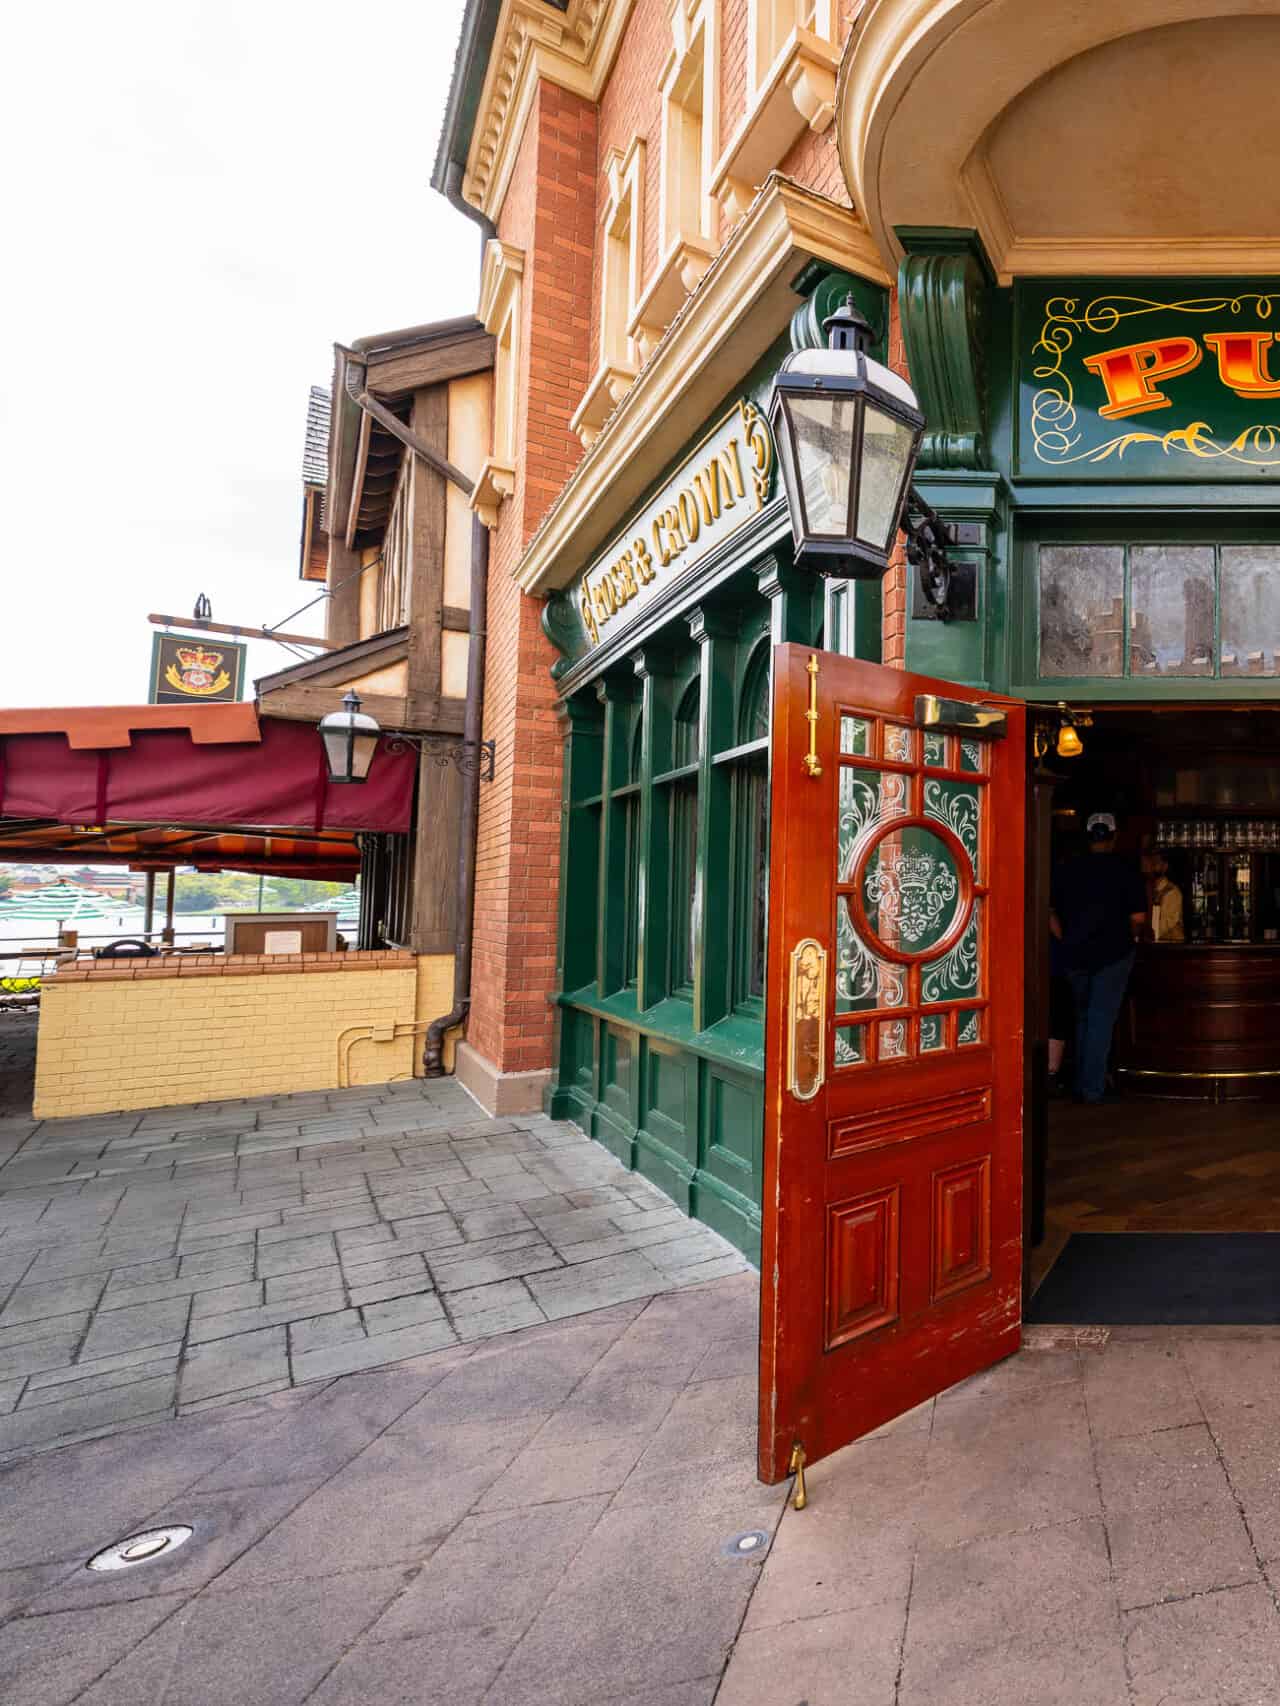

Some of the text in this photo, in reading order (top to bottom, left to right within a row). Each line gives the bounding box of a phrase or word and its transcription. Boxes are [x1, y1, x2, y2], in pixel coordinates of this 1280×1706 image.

[593, 440, 745, 626] ROSE & CROWN
